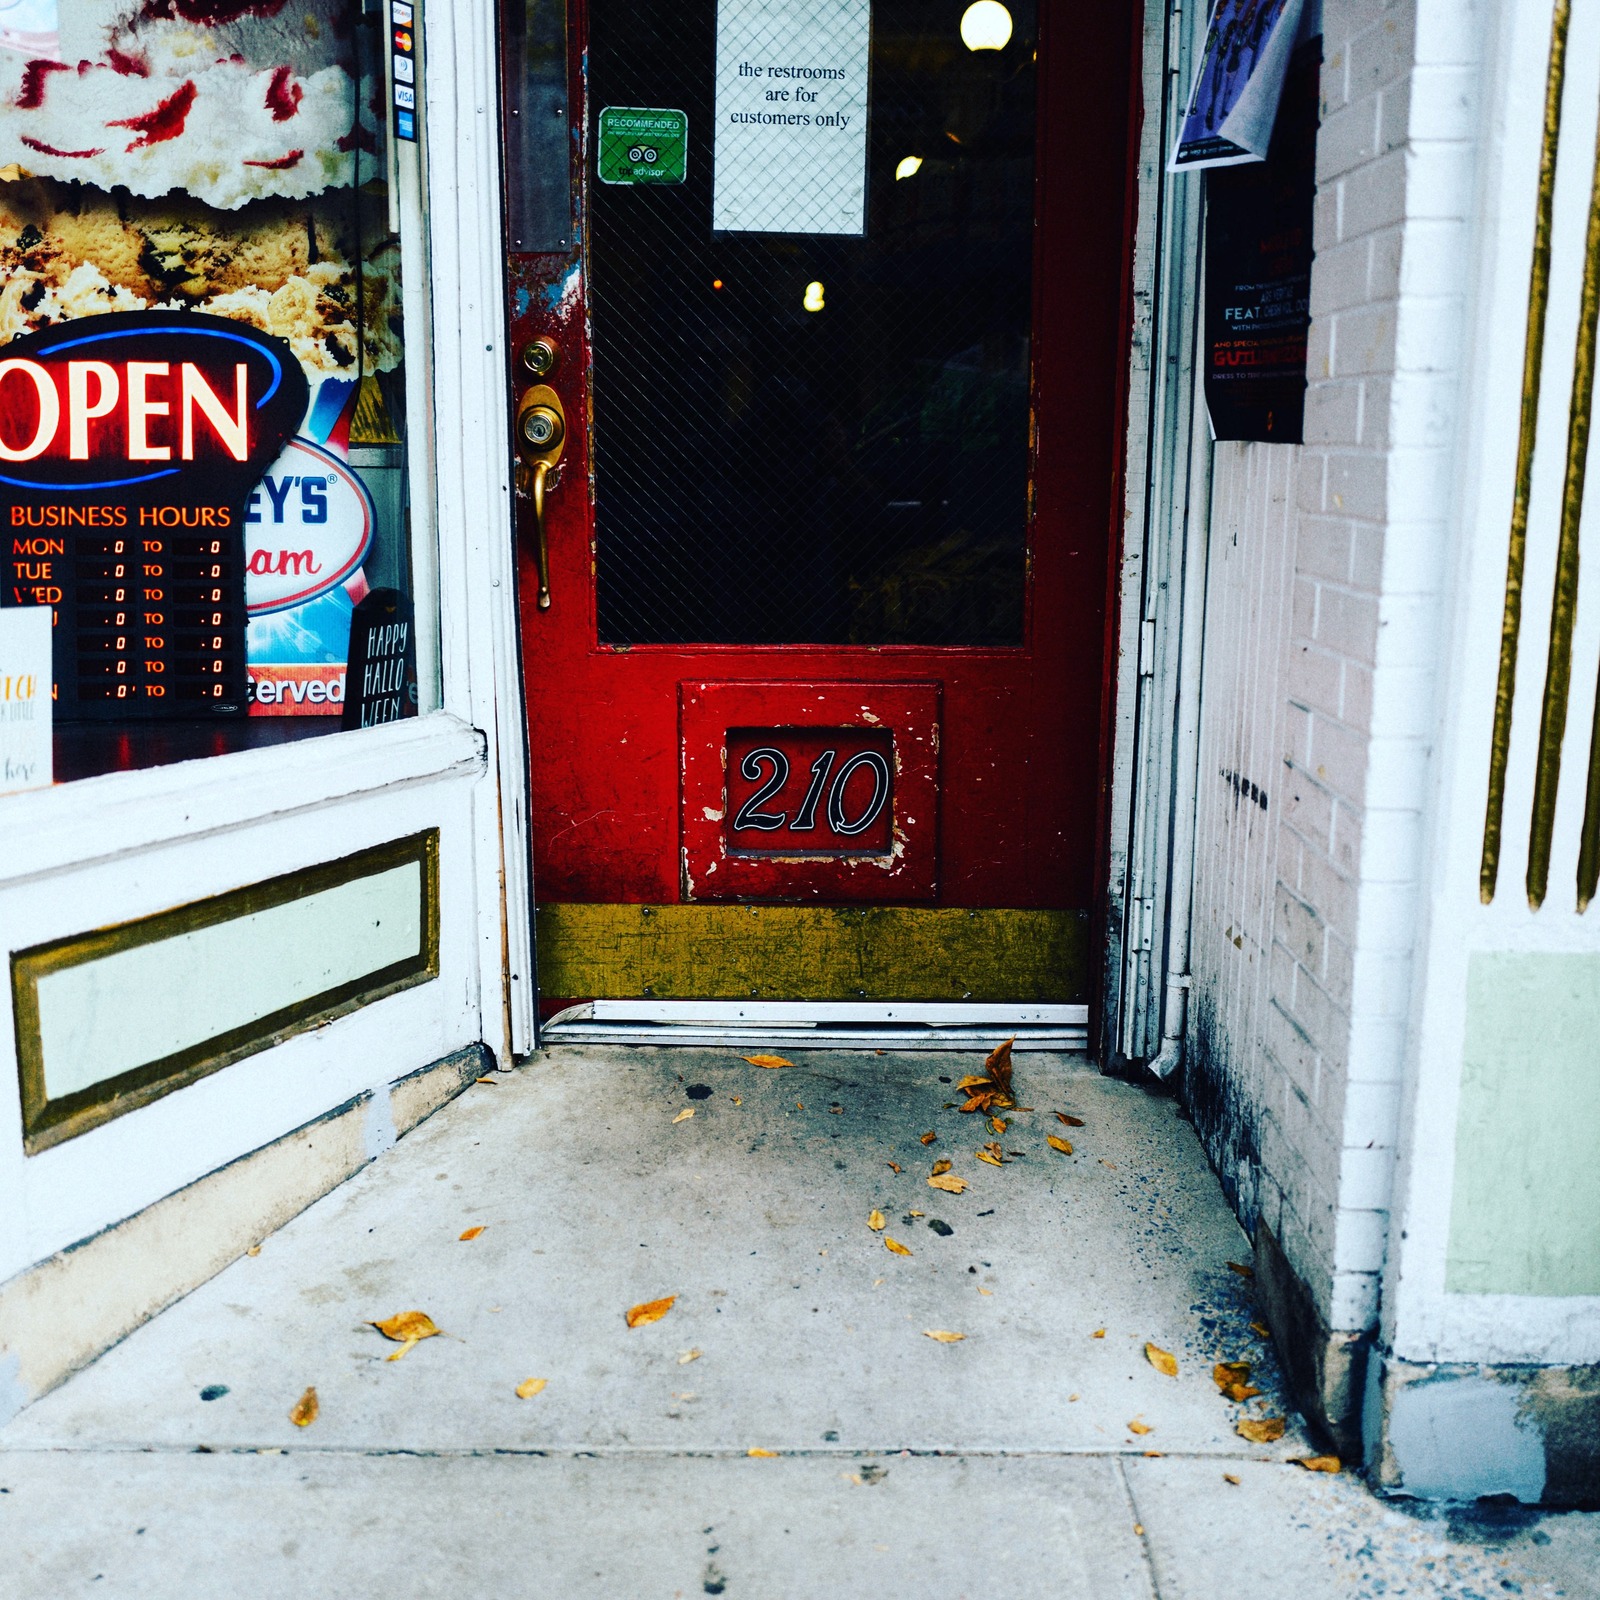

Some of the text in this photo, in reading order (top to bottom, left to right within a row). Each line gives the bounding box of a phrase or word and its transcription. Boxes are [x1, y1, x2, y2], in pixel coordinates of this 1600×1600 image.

[739, 61, 846, 80] the restrooms
[398, 90, 413, 102] VISA
[765, 87, 818, 102] are for
[607, 118, 680, 130] RECOMMENDED
[730, 111, 851, 130] customers only
[1213, 341, 1232, 349] AND
[0, 357, 249, 463] OPEN
[11, 506, 231, 527] BUSINESS HOURS
[12, 538, 65, 556] MON
[142, 540, 163, 553] TO
[13, 562, 53, 580] TUE
[142, 564, 164, 577] TO
[143, 588, 164, 601] TO
[143, 612, 165, 625] TO
[144, 636, 165, 649] TO
[366, 622, 408, 659] HAPPY
[144, 660, 165, 673] TO
[363, 658, 404, 698] HALLO
[145, 684, 166, 697] TO
[733, 748, 889, 835] 210
